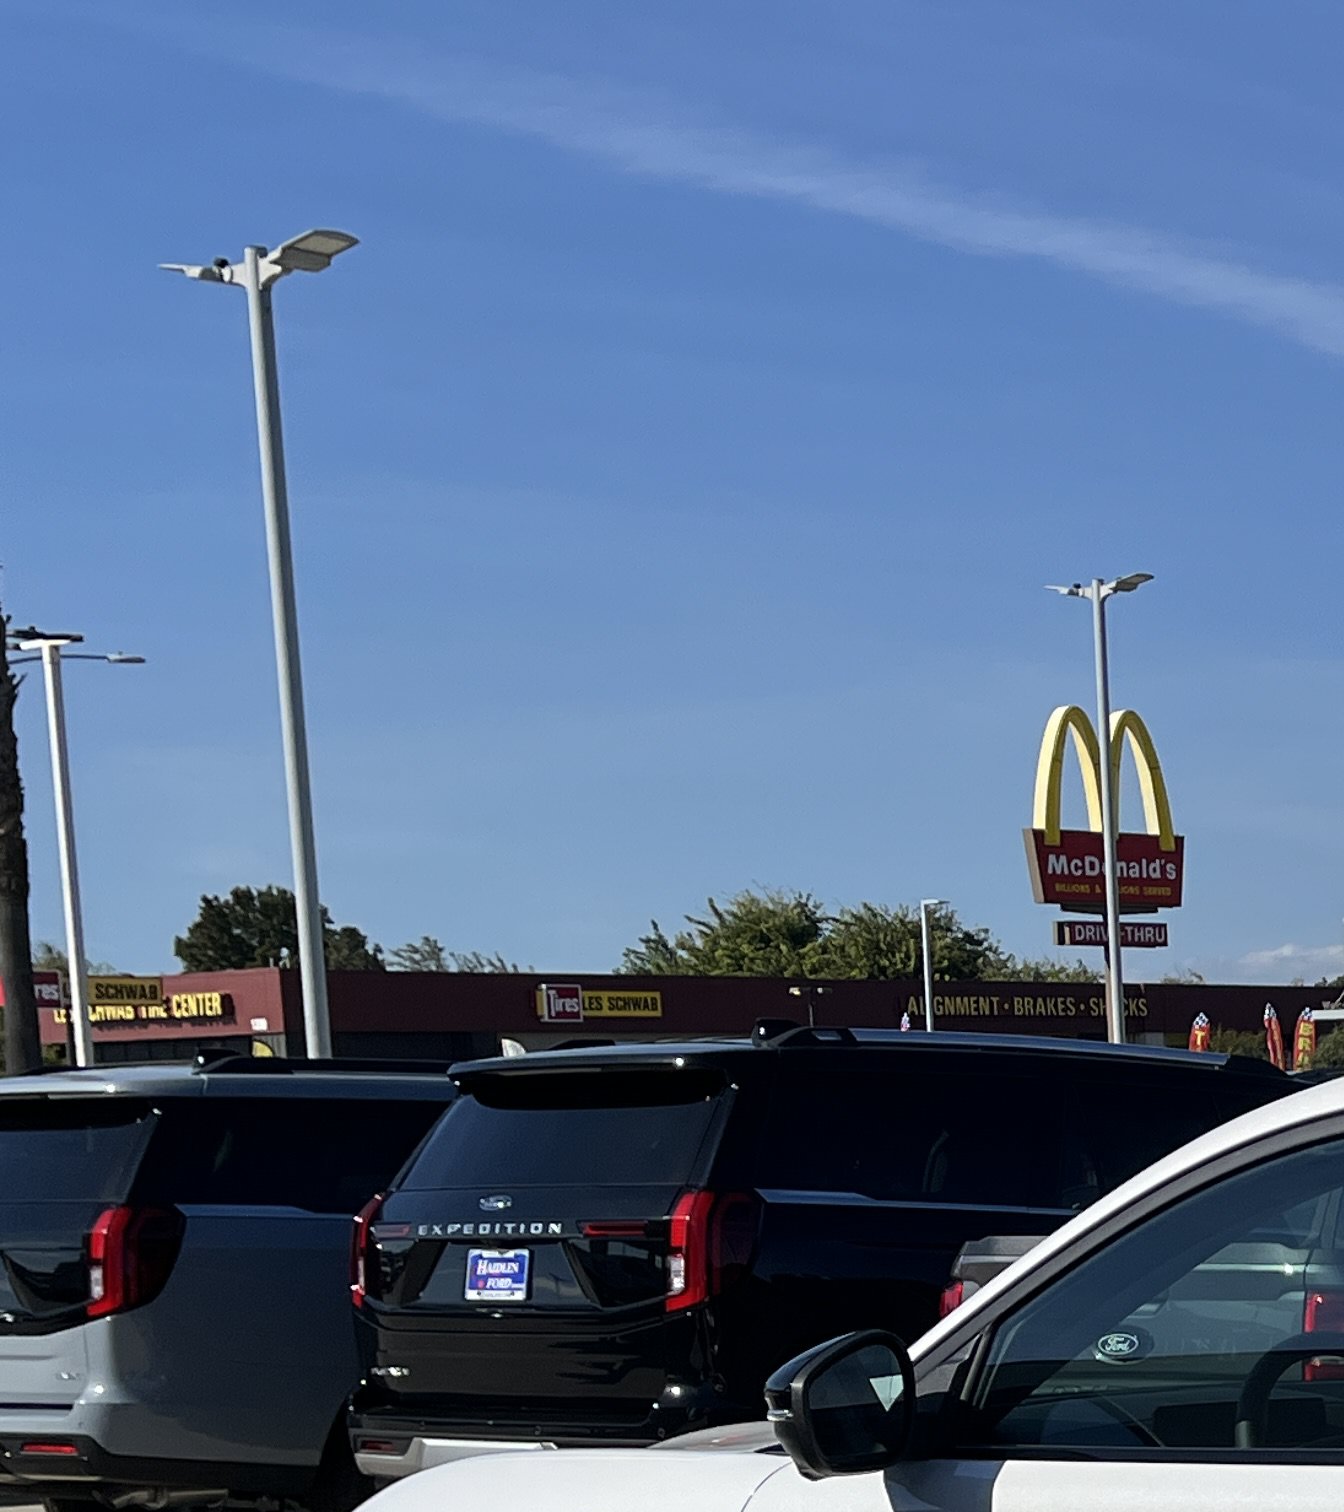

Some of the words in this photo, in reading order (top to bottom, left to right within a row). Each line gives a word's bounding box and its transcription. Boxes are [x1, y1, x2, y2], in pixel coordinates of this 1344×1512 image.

[1047, 853, 1177, 881] McDnald's
[95, 983, 158, 1000] SCHWAB
[548, 989, 579, 1017] Tires
[582, 996, 603, 1011] LES
[608, 996, 659, 1012] SCHWAB
[172, 992, 222, 1018] CENTER
[907, 996, 1000, 1017] ALGNMENT
[1014, 996, 1076, 1017] BRAKES
[1090, 998, 1148, 1017] SHCKS
[418, 1222, 562, 1236] EXPEDITION
